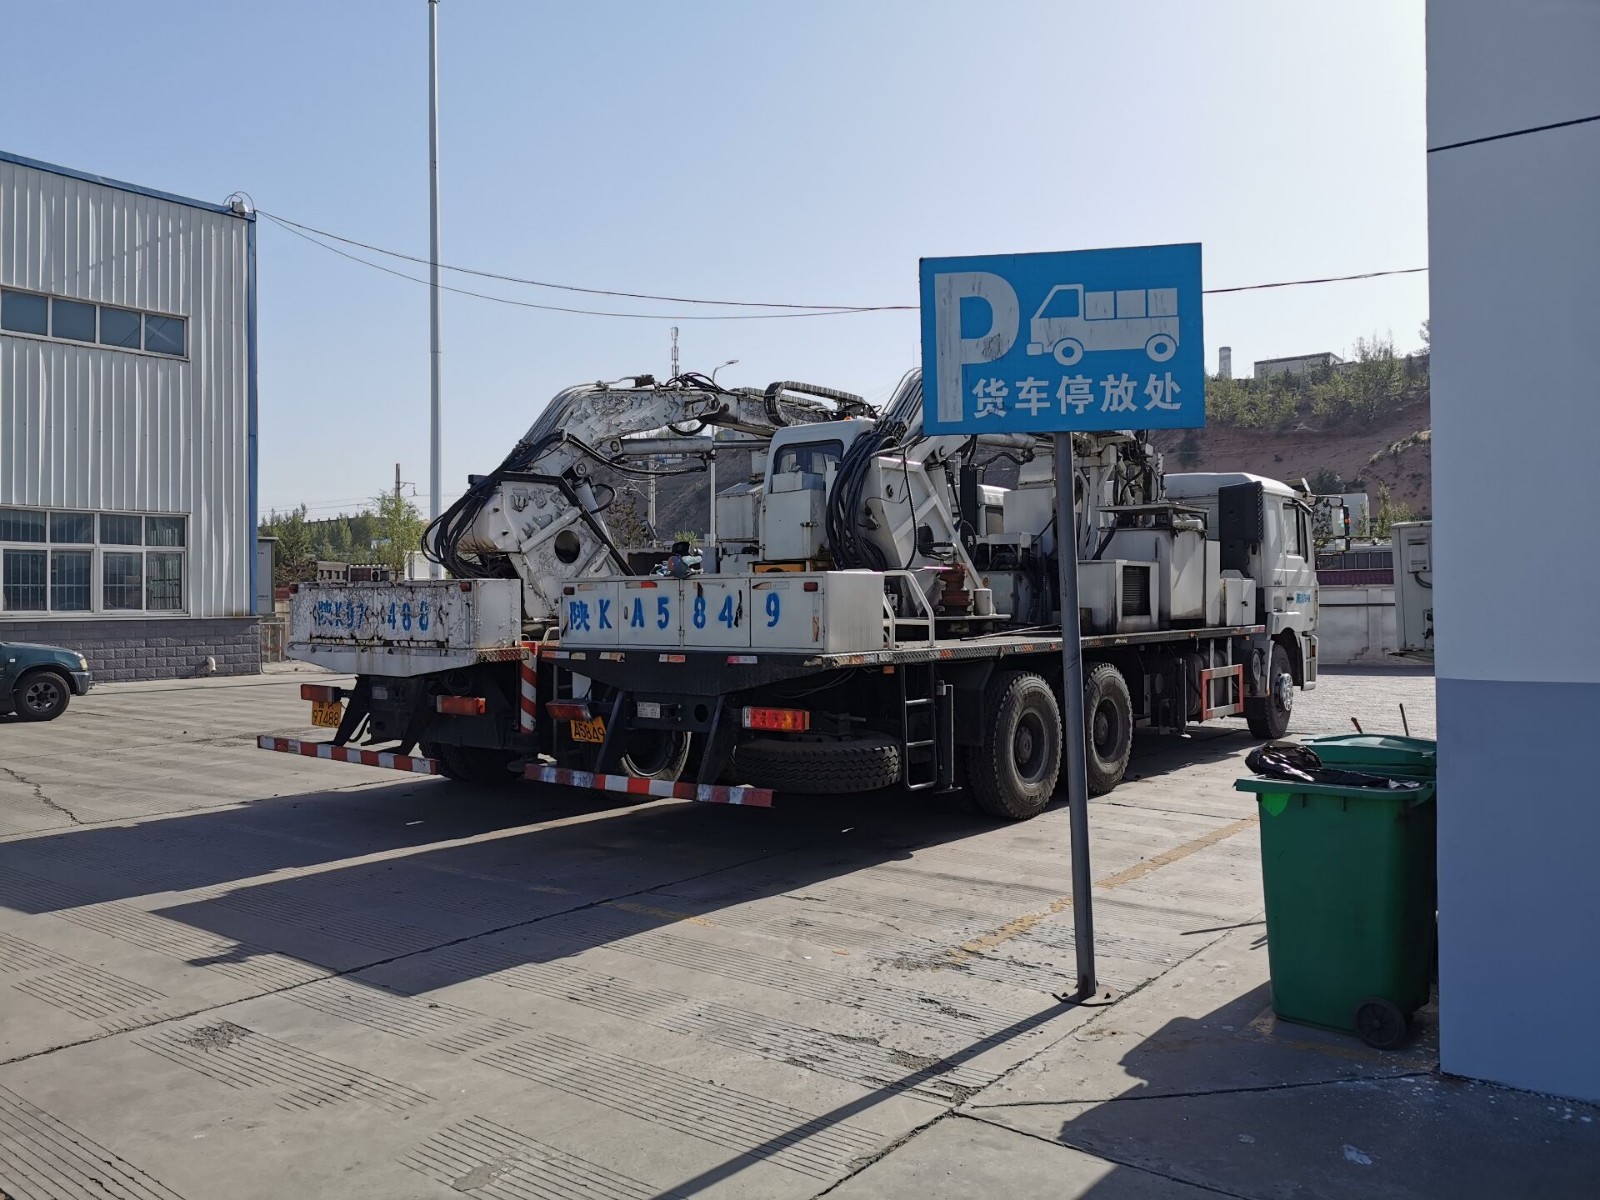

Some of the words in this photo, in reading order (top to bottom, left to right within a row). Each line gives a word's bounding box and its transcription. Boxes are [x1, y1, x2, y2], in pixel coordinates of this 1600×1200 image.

[934, 271, 1020, 423] P
[972, 372, 1183, 419] 货车停放处
[312, 709, 339, 726] 97488
[574, 719, 605, 741] A5849
